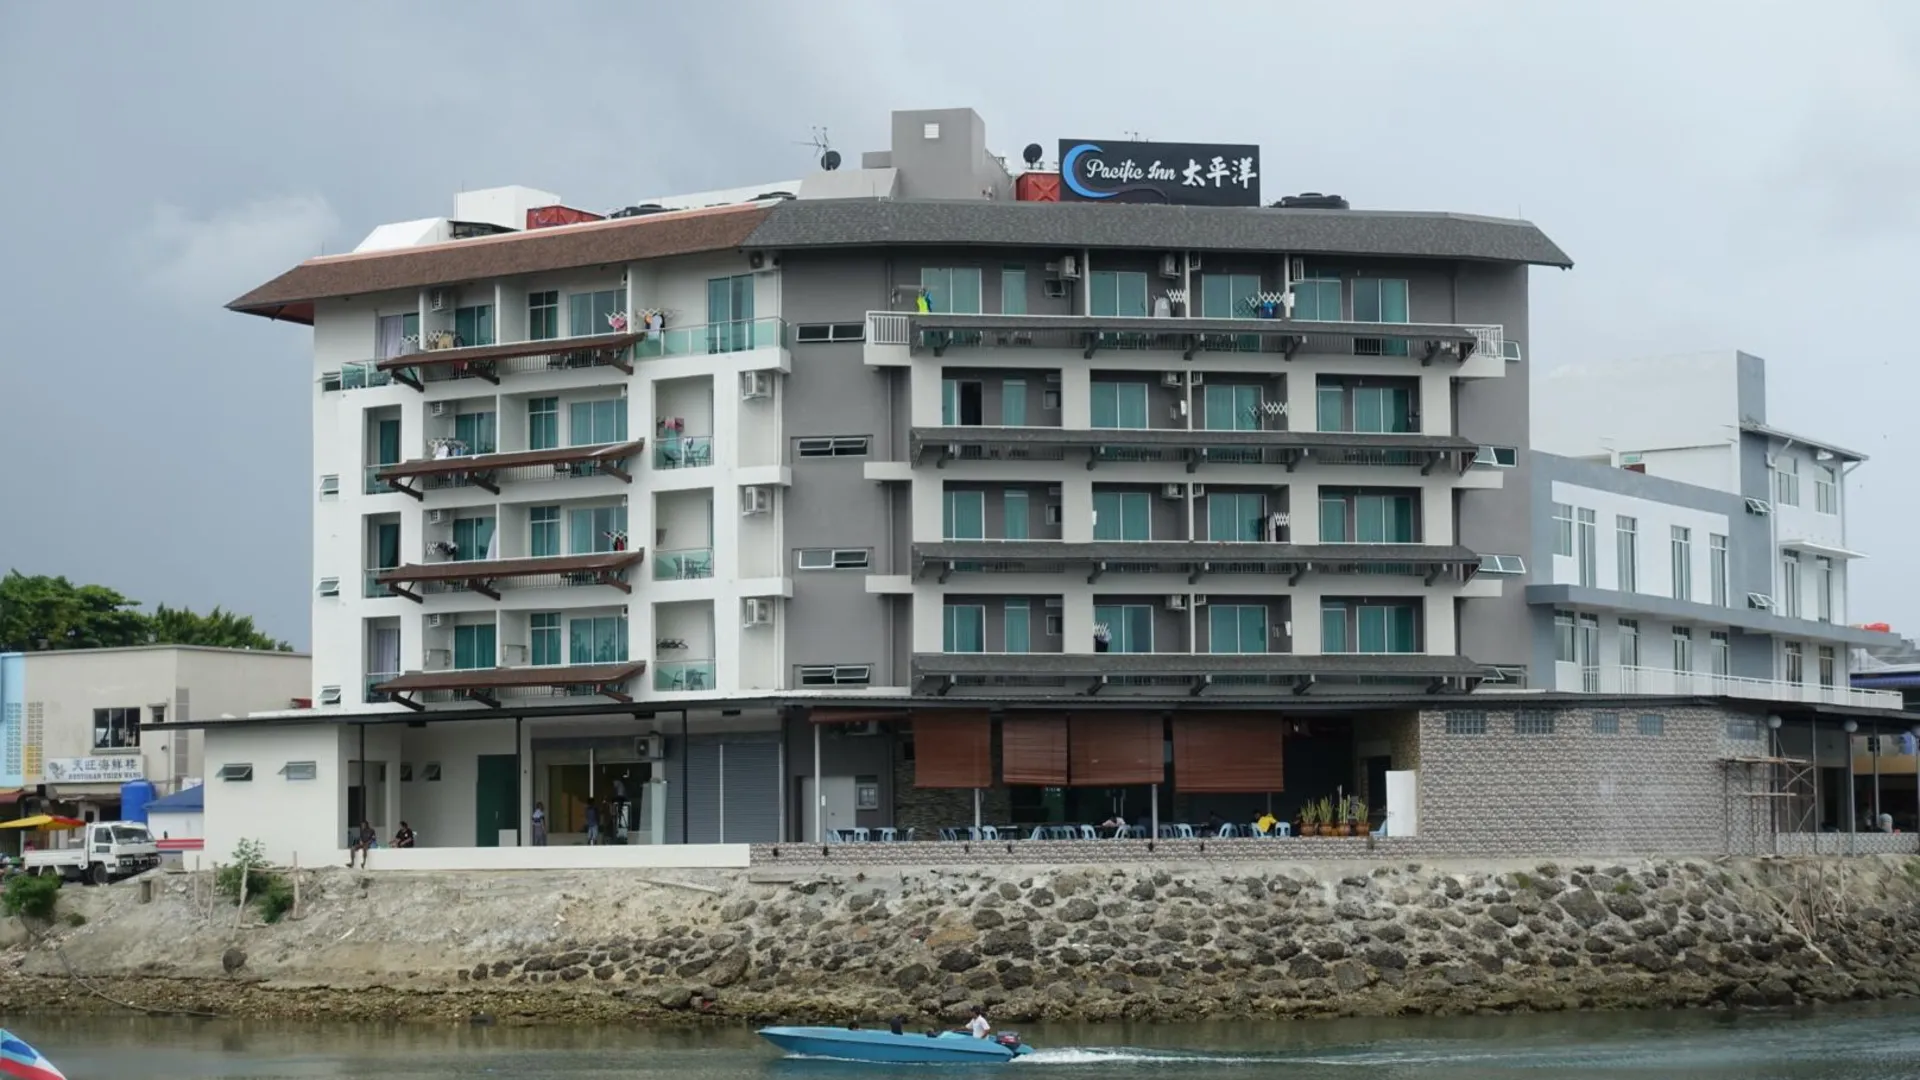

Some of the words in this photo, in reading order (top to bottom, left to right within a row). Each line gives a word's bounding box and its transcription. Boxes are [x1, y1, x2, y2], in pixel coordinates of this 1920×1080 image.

[1086, 158, 1144, 183] Pacific
[1147, 160, 1176, 181] Inn
[1181, 156, 1257, 189] 太平洋
